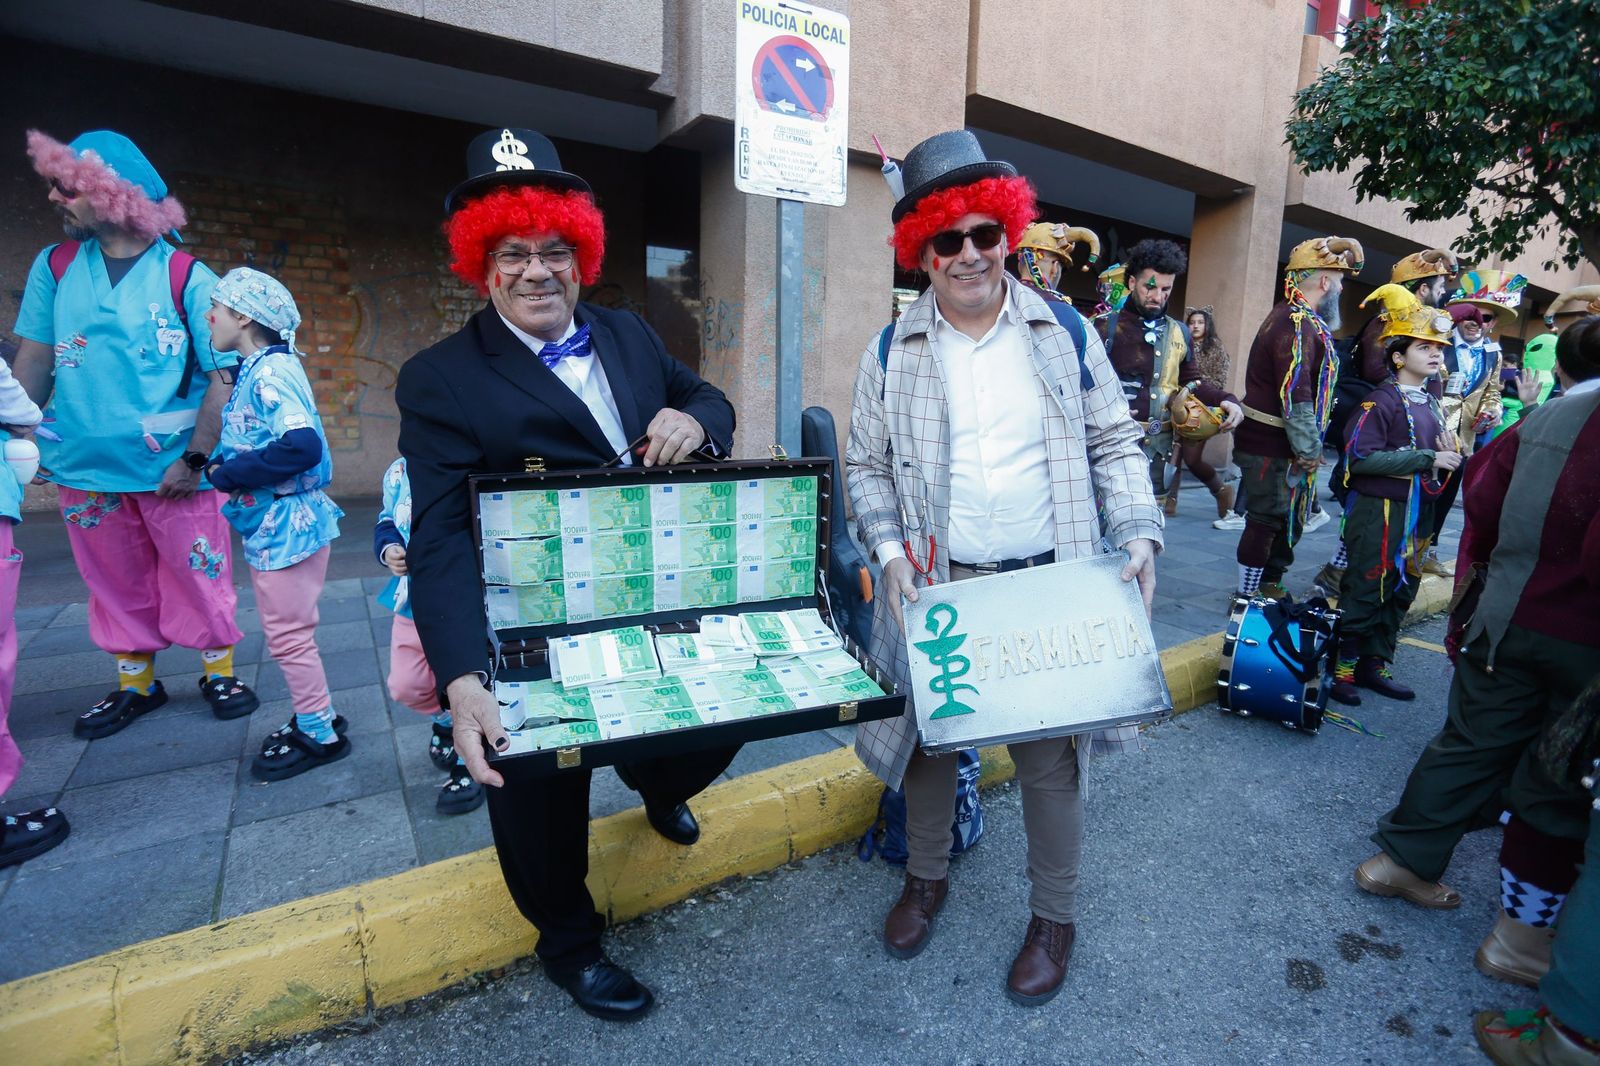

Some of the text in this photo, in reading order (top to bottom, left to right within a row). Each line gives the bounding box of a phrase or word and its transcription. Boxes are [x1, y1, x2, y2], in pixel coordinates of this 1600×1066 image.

[742, 2, 846, 45] POLICIA LOCAL
[972, 616, 1150, 681] FARMAFIA
